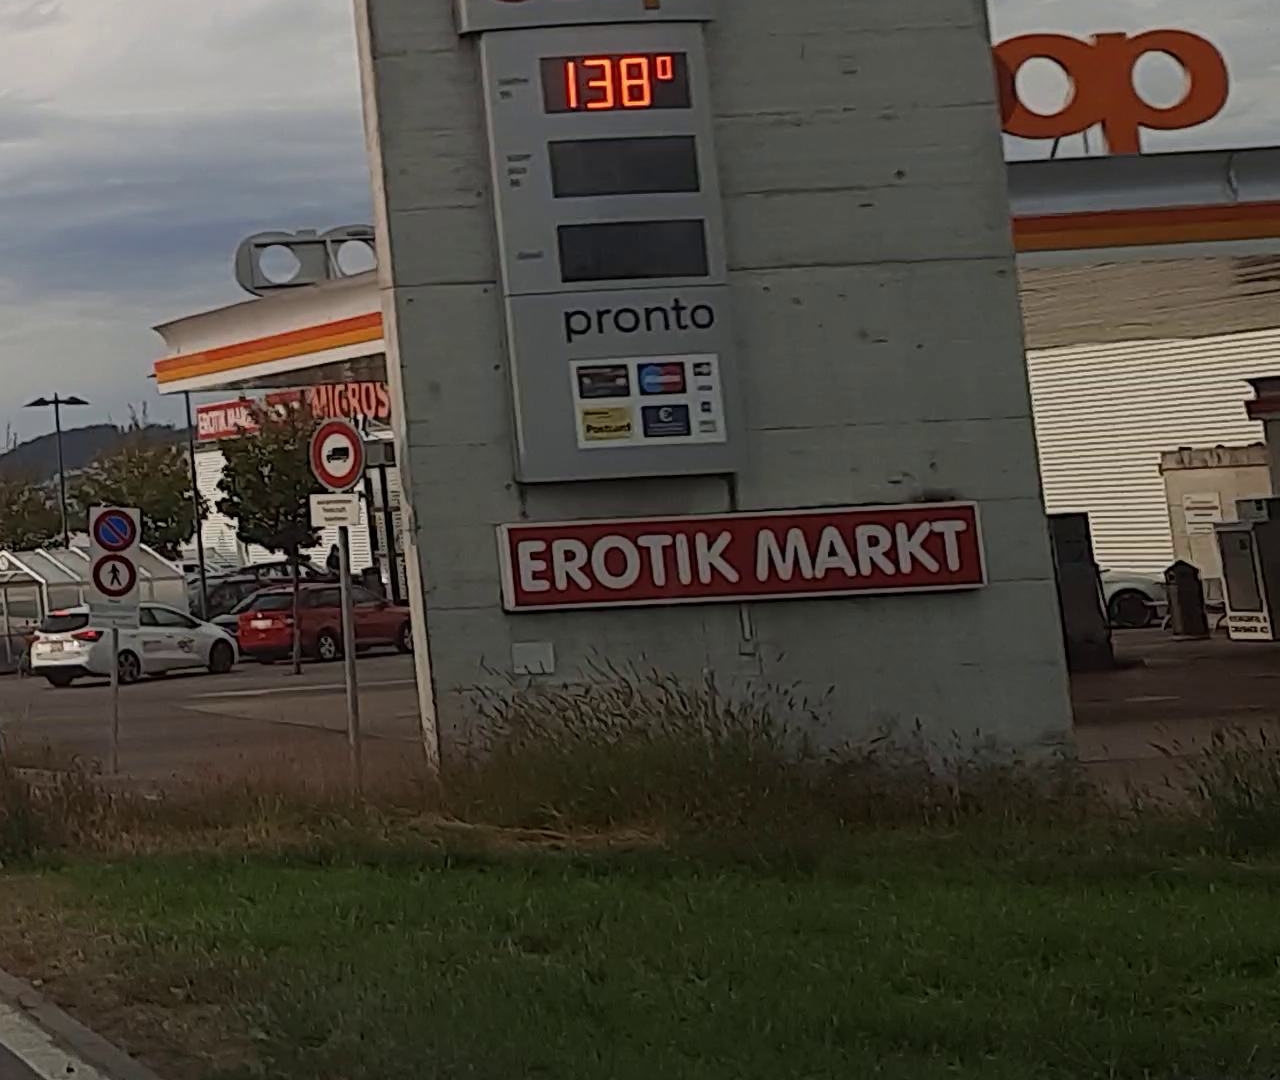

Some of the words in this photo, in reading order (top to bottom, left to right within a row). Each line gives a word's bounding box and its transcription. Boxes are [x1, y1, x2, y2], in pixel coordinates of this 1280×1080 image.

[993, 29, 1229, 154] op
[564, 298, 715, 344] pronto
[516, 530, 740, 593] EROTIK
[756, 520, 968, 583] MARKT
